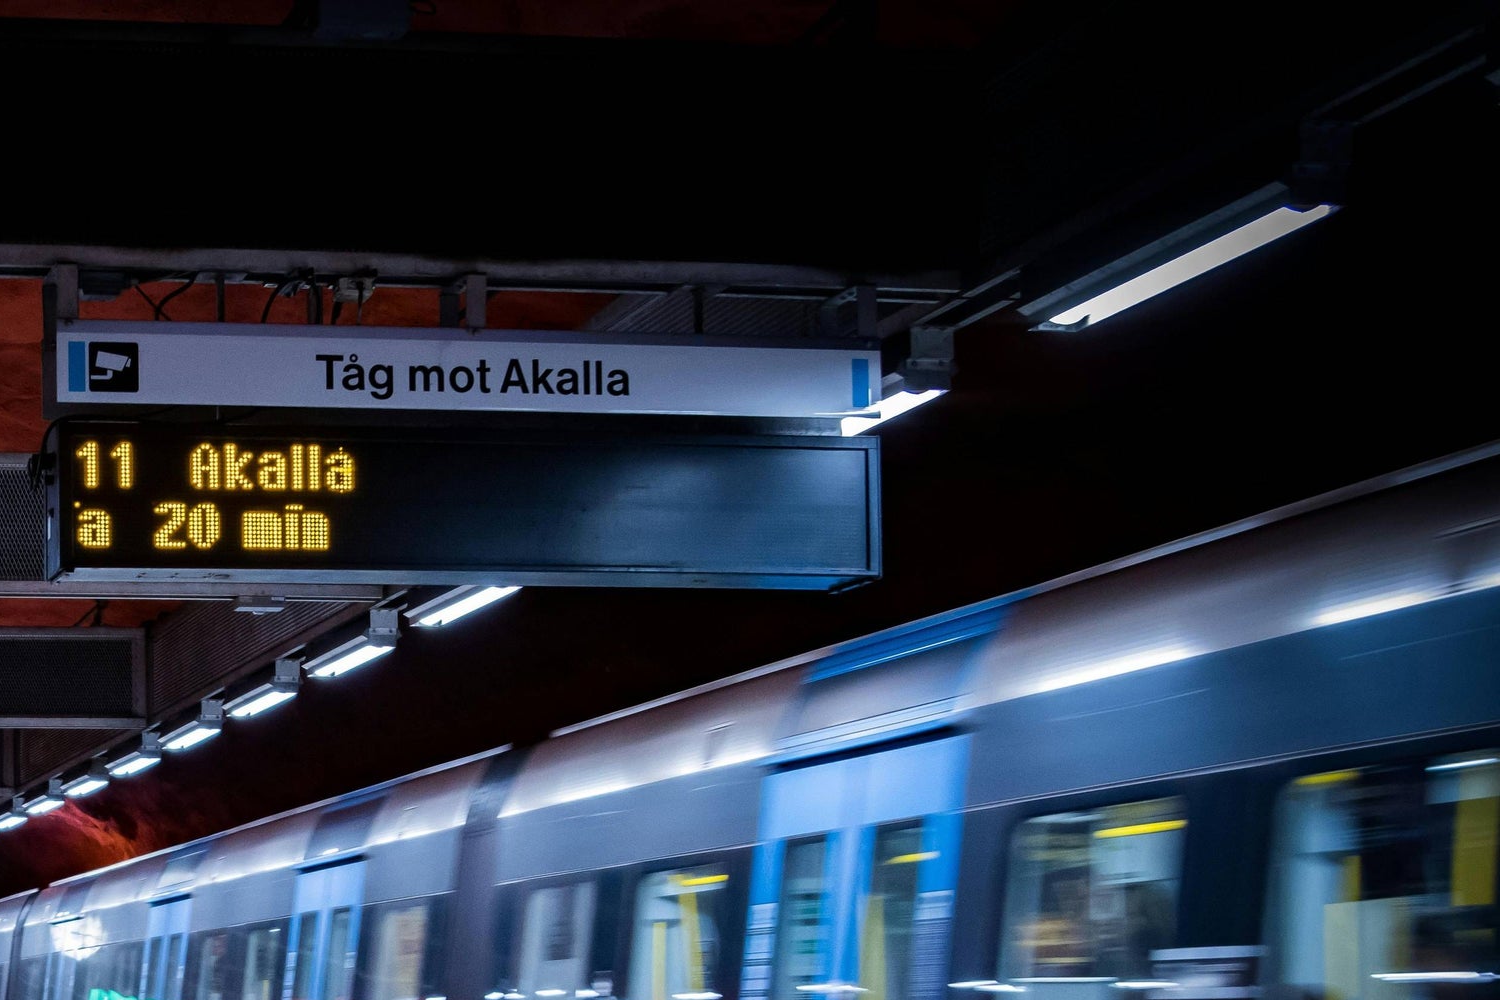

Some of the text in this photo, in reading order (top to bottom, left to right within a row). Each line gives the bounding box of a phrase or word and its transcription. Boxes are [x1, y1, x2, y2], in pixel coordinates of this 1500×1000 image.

[315, 353, 630, 400] Tåg mot Akalla
[76, 441, 355, 493] 11 Akalla
[153, 502, 220, 549] 20
[241, 503, 330, 550] min
